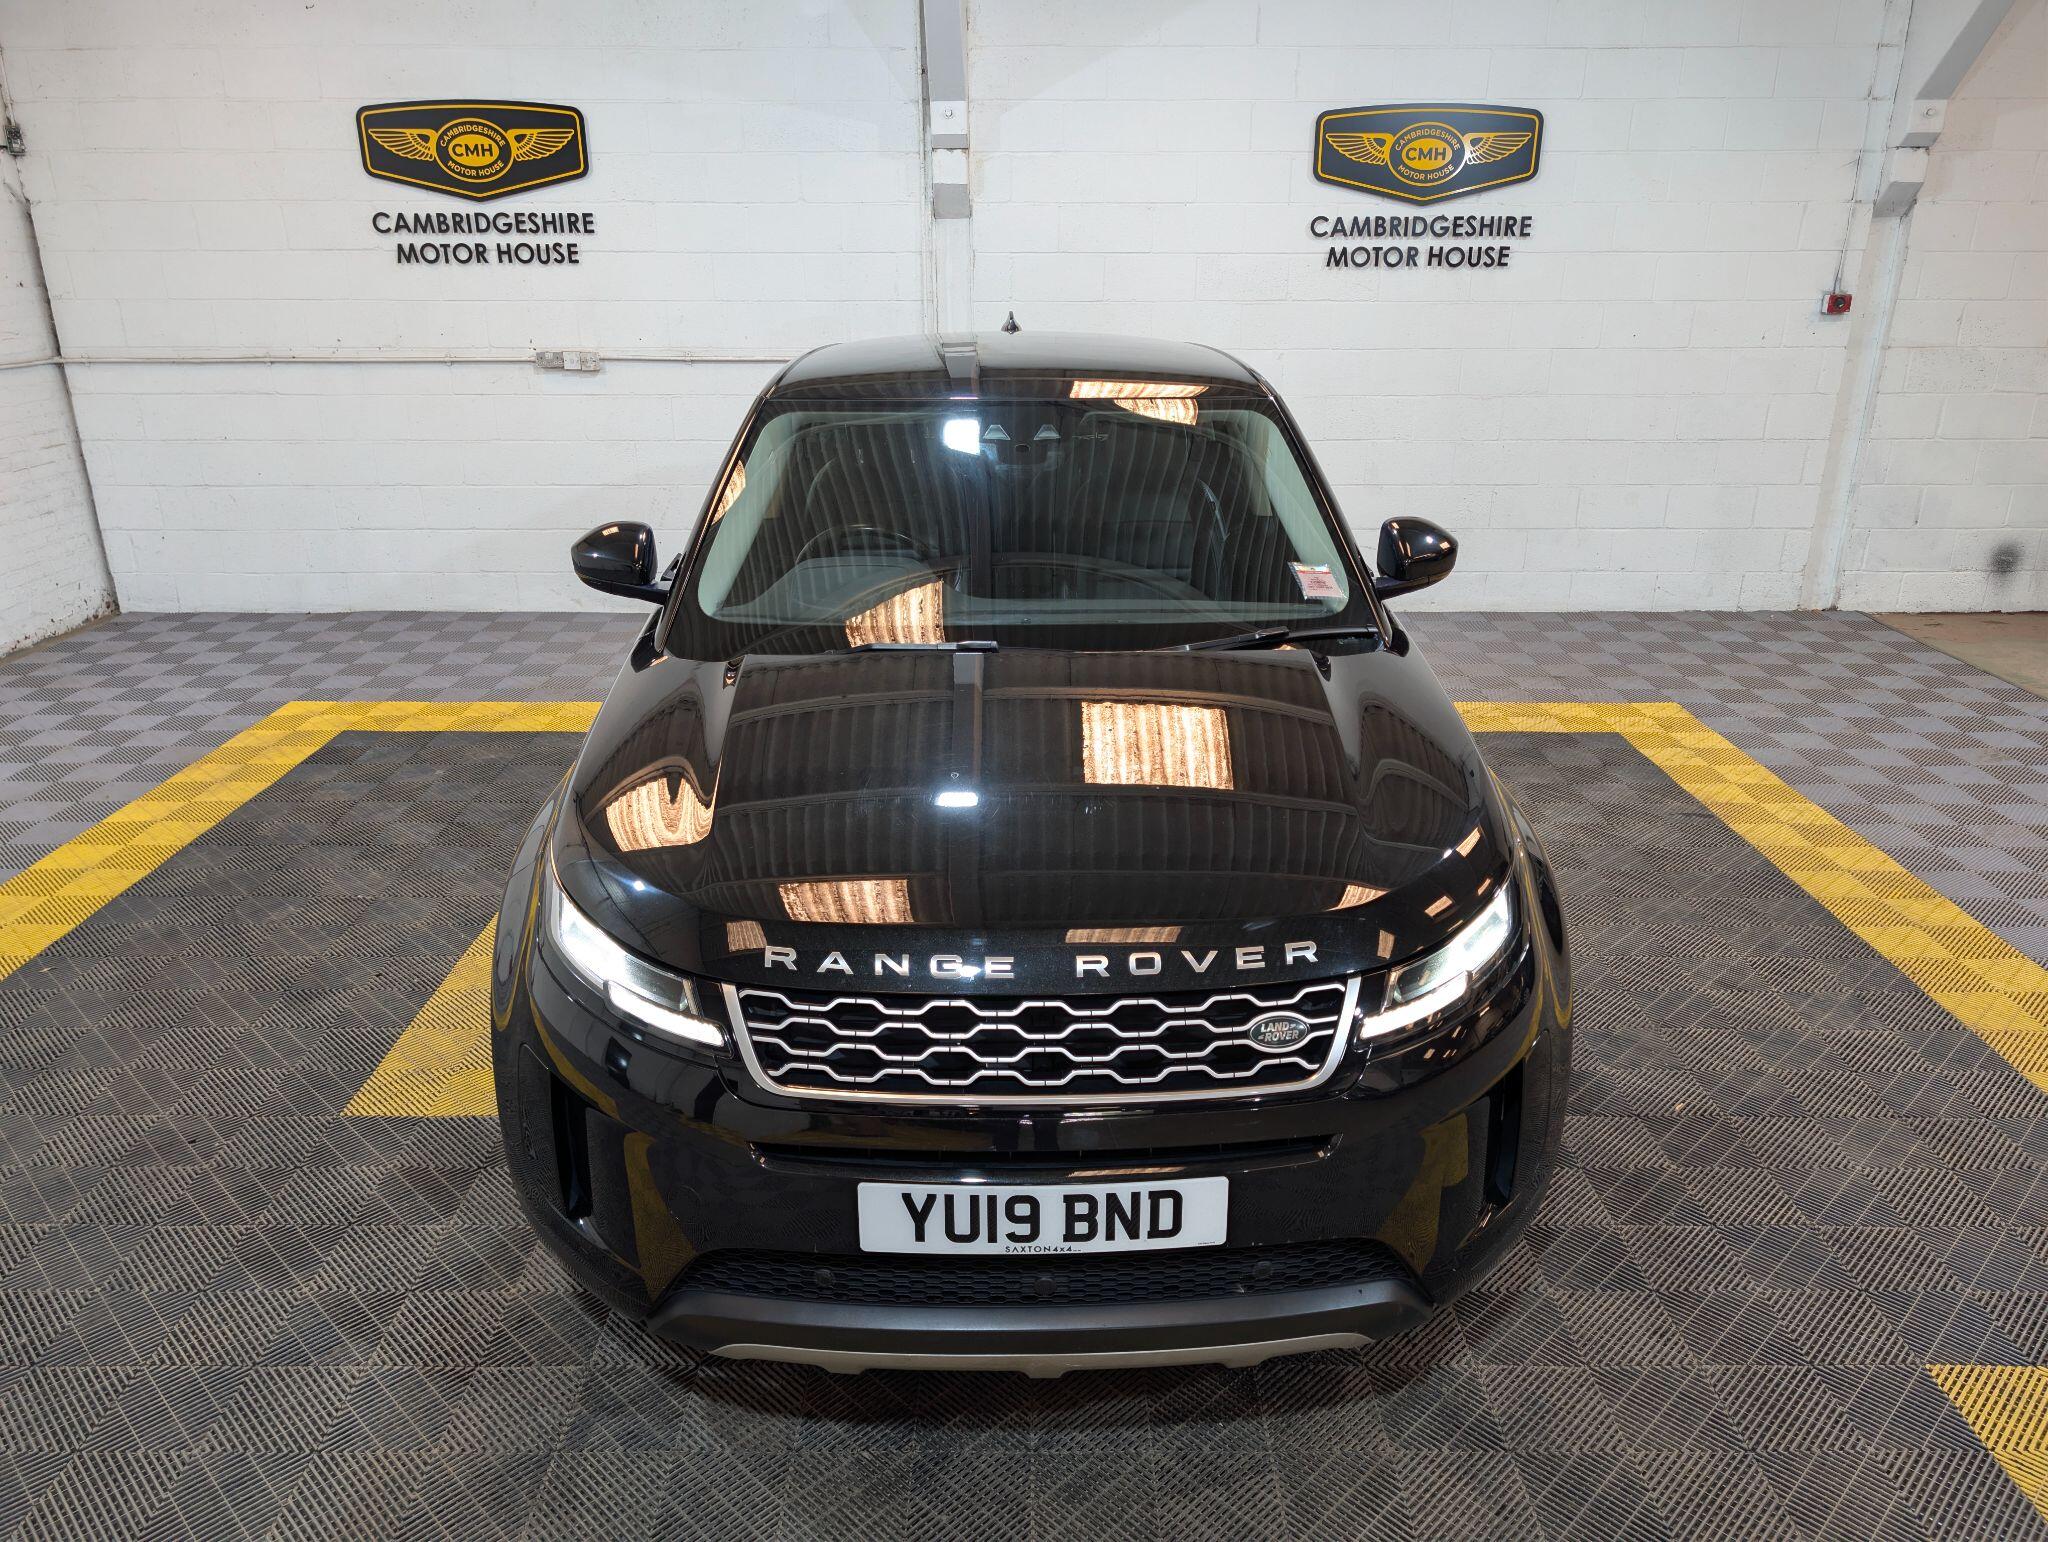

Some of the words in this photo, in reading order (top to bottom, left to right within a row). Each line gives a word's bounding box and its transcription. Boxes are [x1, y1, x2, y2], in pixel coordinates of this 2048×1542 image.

[440, 124, 506, 148] CAMBRIDGESHIRE
[1395, 128, 1461, 152] CAMBRIDGESHIRE
[452, 143, 494, 158] CMH
[1405, 147, 1447, 161] CMH
[447, 160, 477, 177] MOTOR
[479, 160, 504, 177] HOUSE
[1397, 164, 1425, 181] MOTOR
[1427, 163, 1455, 181] HOUSE
[372, 212, 595, 235] CAMBRIDGESHIRE
[1310, 215, 1533, 238] CAMBRIDGESHIRE
[397, 243, 489, 265] MOTOR
[497, 242, 580, 265] HOUSE
[1326, 246, 1419, 268] MOTOR
[1427, 245, 1511, 268] HOUSE
[764, 945, 1015, 979] RANGE
[1075, 940, 1319, 978] ROVER
[1260, 1021, 1290, 1032] LAND
[1264, 1030, 1300, 1042] ROVER
[901, 1191, 1041, 1244] YU19
[1062, 1189, 1183, 1243] BND
